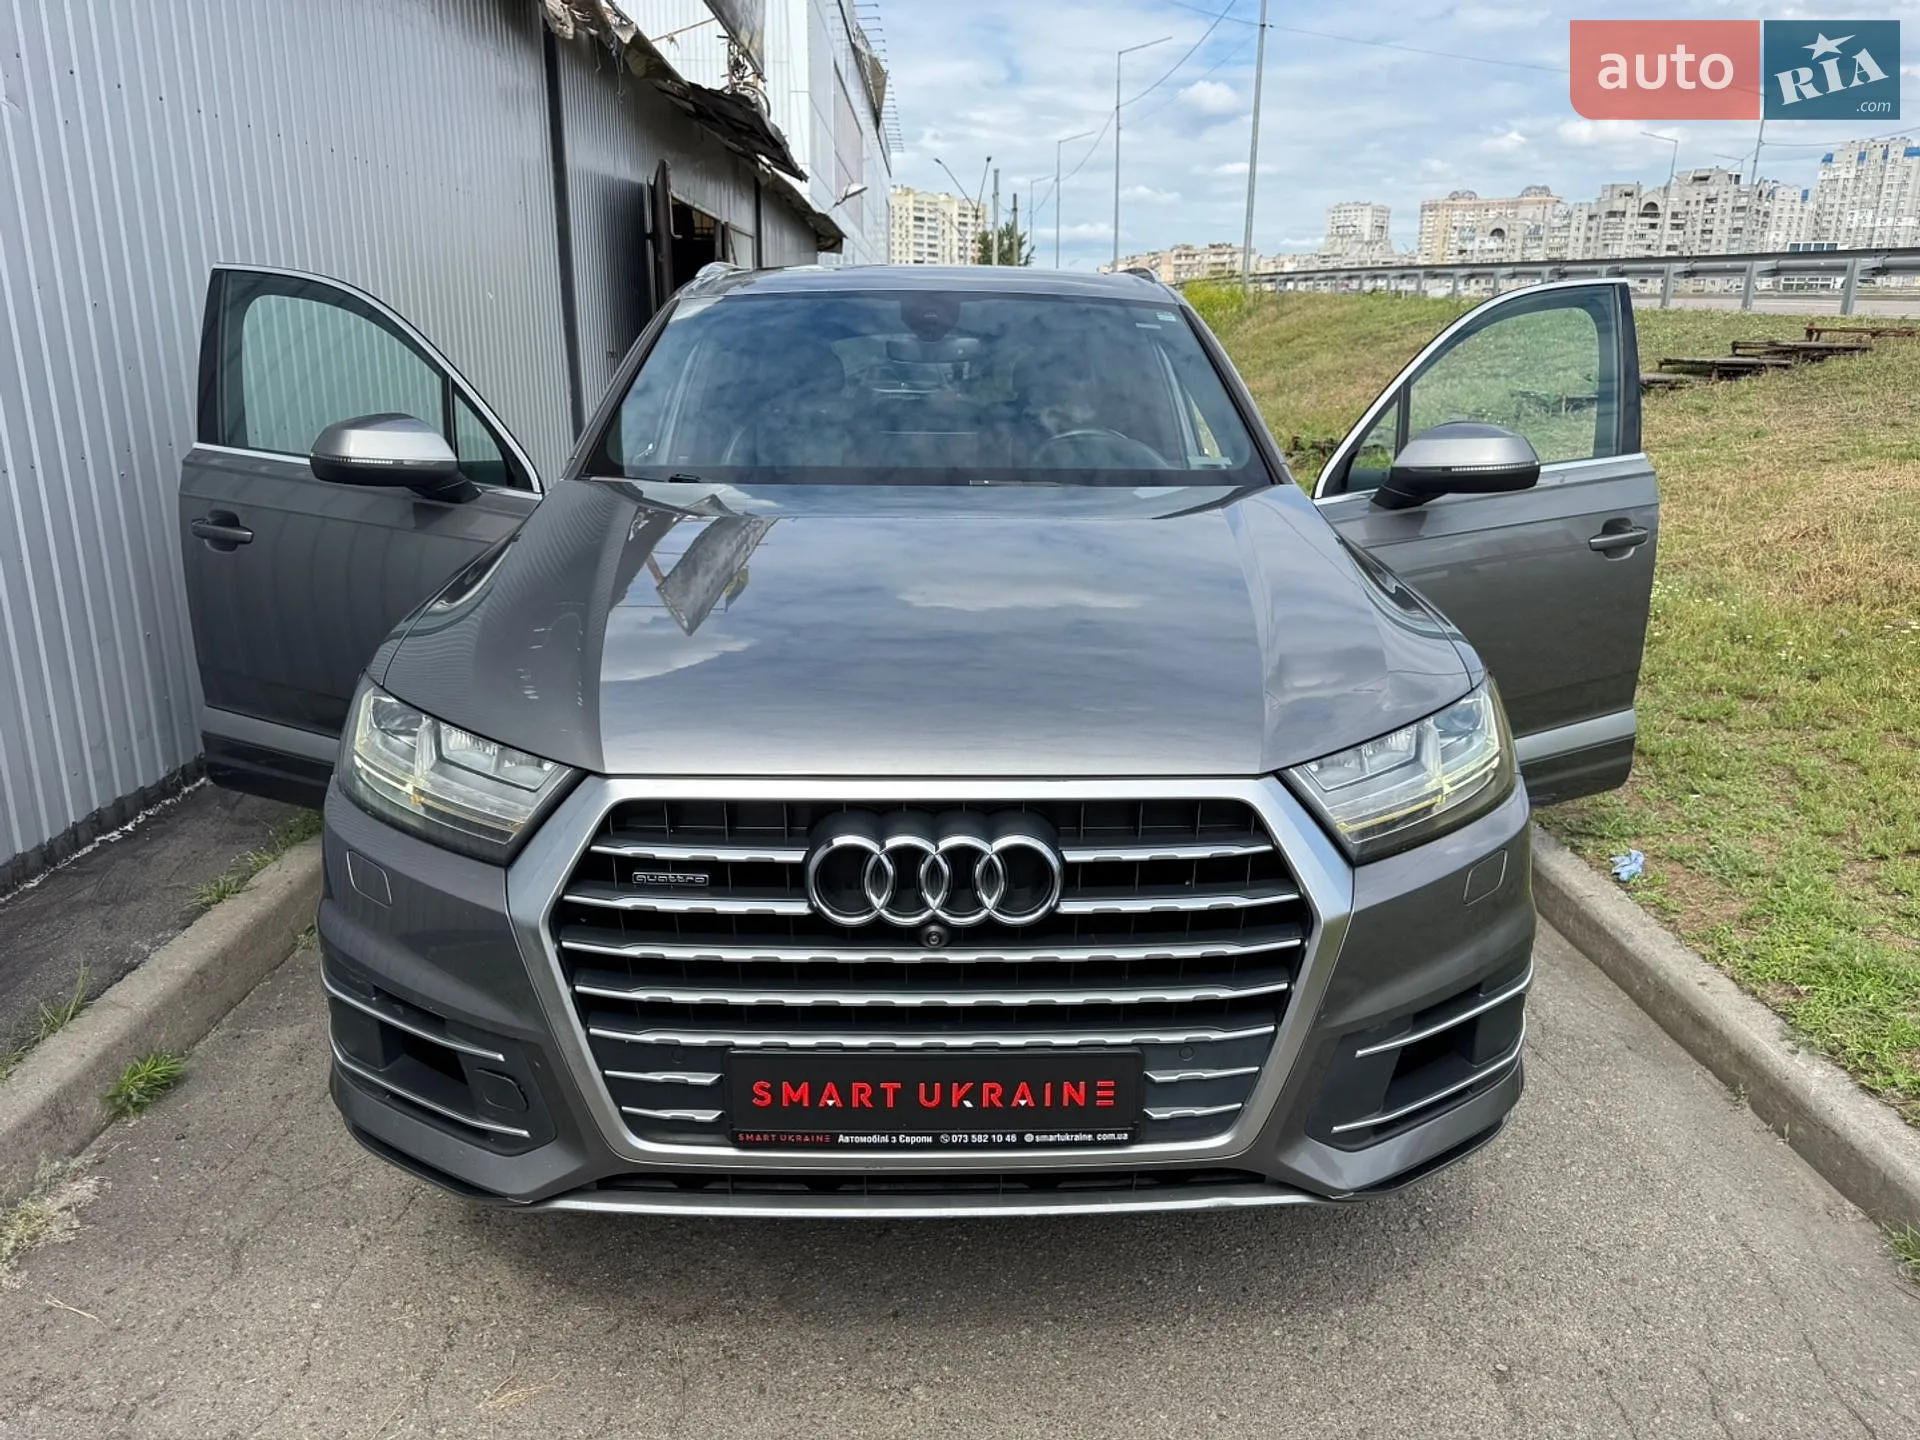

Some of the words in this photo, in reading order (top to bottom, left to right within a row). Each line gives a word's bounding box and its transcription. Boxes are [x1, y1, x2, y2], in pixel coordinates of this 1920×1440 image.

[636, 874, 705, 883] quattro
[752, 1081, 901, 1108] SMART
[918, 1081, 1115, 1108] UKRAINE
[738, 1133, 776, 1142] SMART
[779, 1134, 831, 1143] UKRAINE
[838, 1134, 889, 1143] Автомобілі
[899, 1134, 932, 1145] Європи
[951, 1134, 969, 1143] 073
[991, 1134, 1003, 1143] 10
